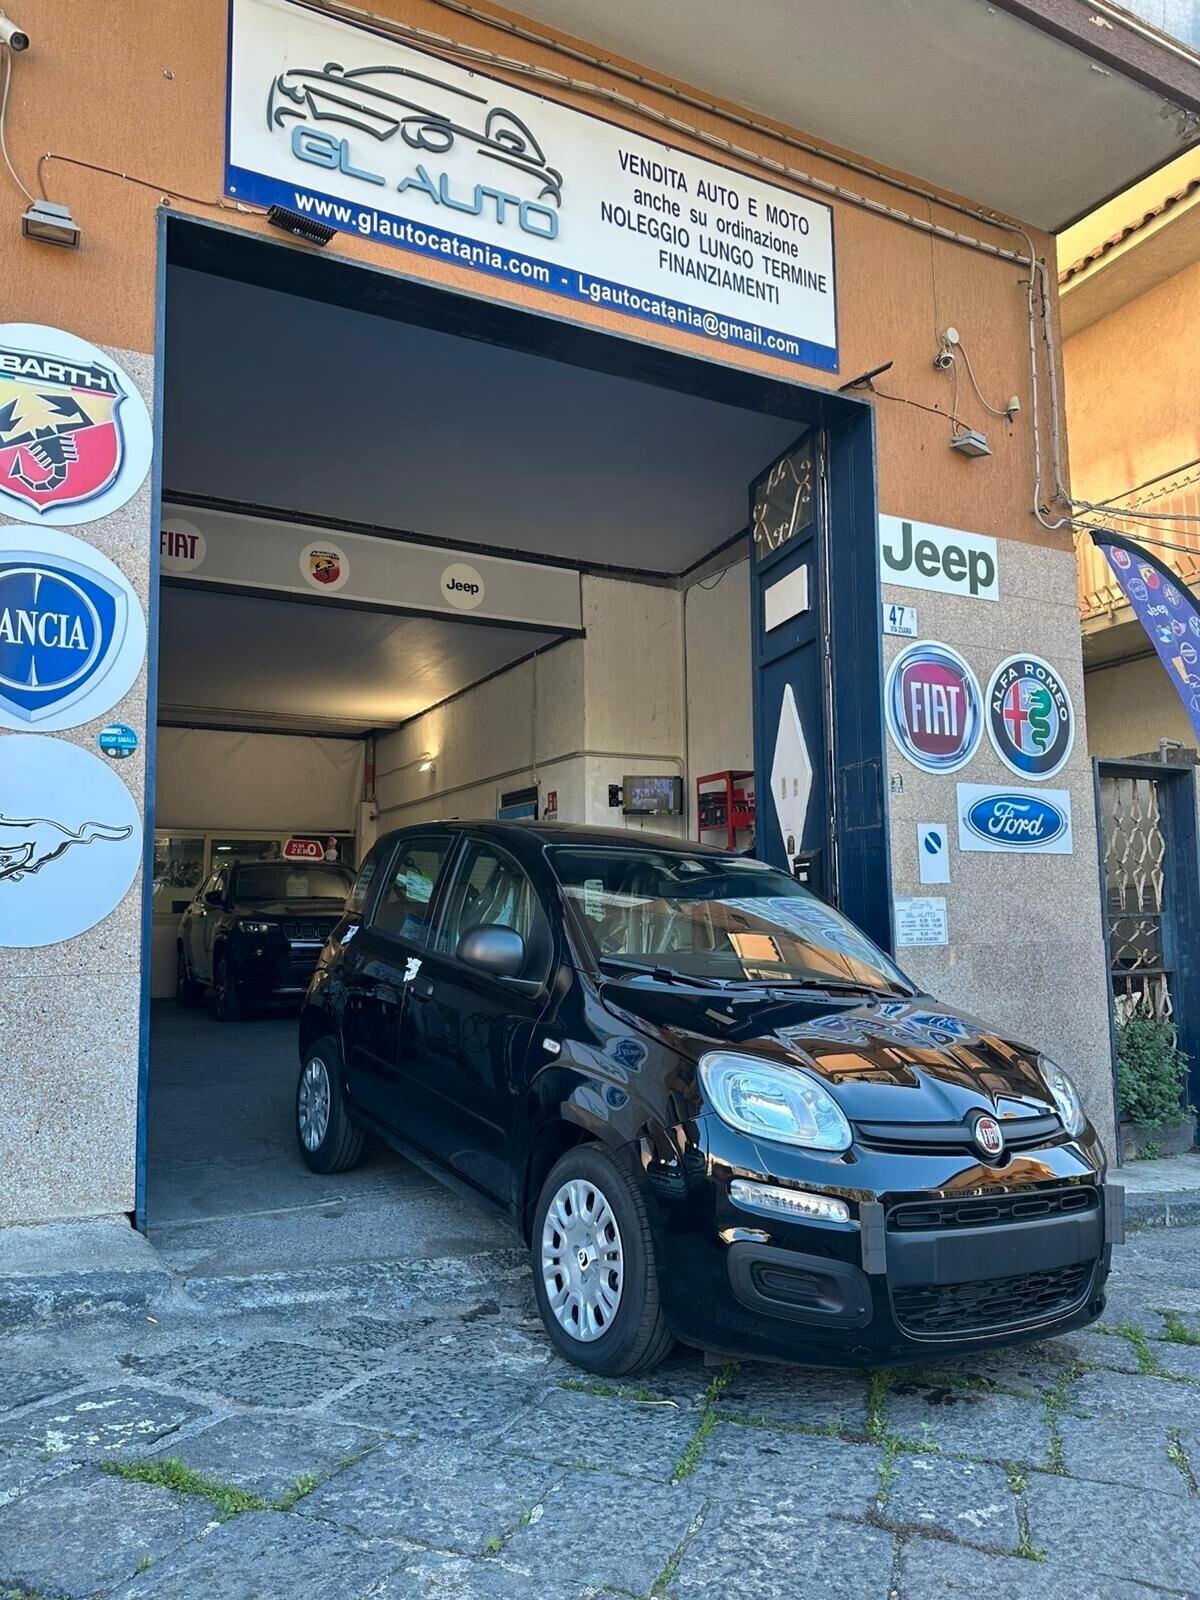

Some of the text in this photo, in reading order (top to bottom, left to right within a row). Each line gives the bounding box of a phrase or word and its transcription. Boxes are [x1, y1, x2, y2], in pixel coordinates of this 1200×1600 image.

[291, 124, 559, 240] GL AUTO
[618, 149, 810, 236] VENDITA AUTO E MOTO
[601, 201, 828, 294] NOLEGGIO LUNGO TERMINE
[633, 188, 799, 258] anche su ordinazione
[294, 192, 551, 283] www.glautocatania.com
[578, 274, 800, 356] Lgautocatania@gmail.com
[659, 249, 780, 305] FINANZIAMENTI
[446, 578, 480, 595] Jeep
[882, 521, 995, 595] Jeep
[890, 605, 905, 626] 47
[910, 681, 960, 736] FIAT
[992, 663, 1068, 722] ALFA ROMEO
[988, 801, 1045, 836] Ford
